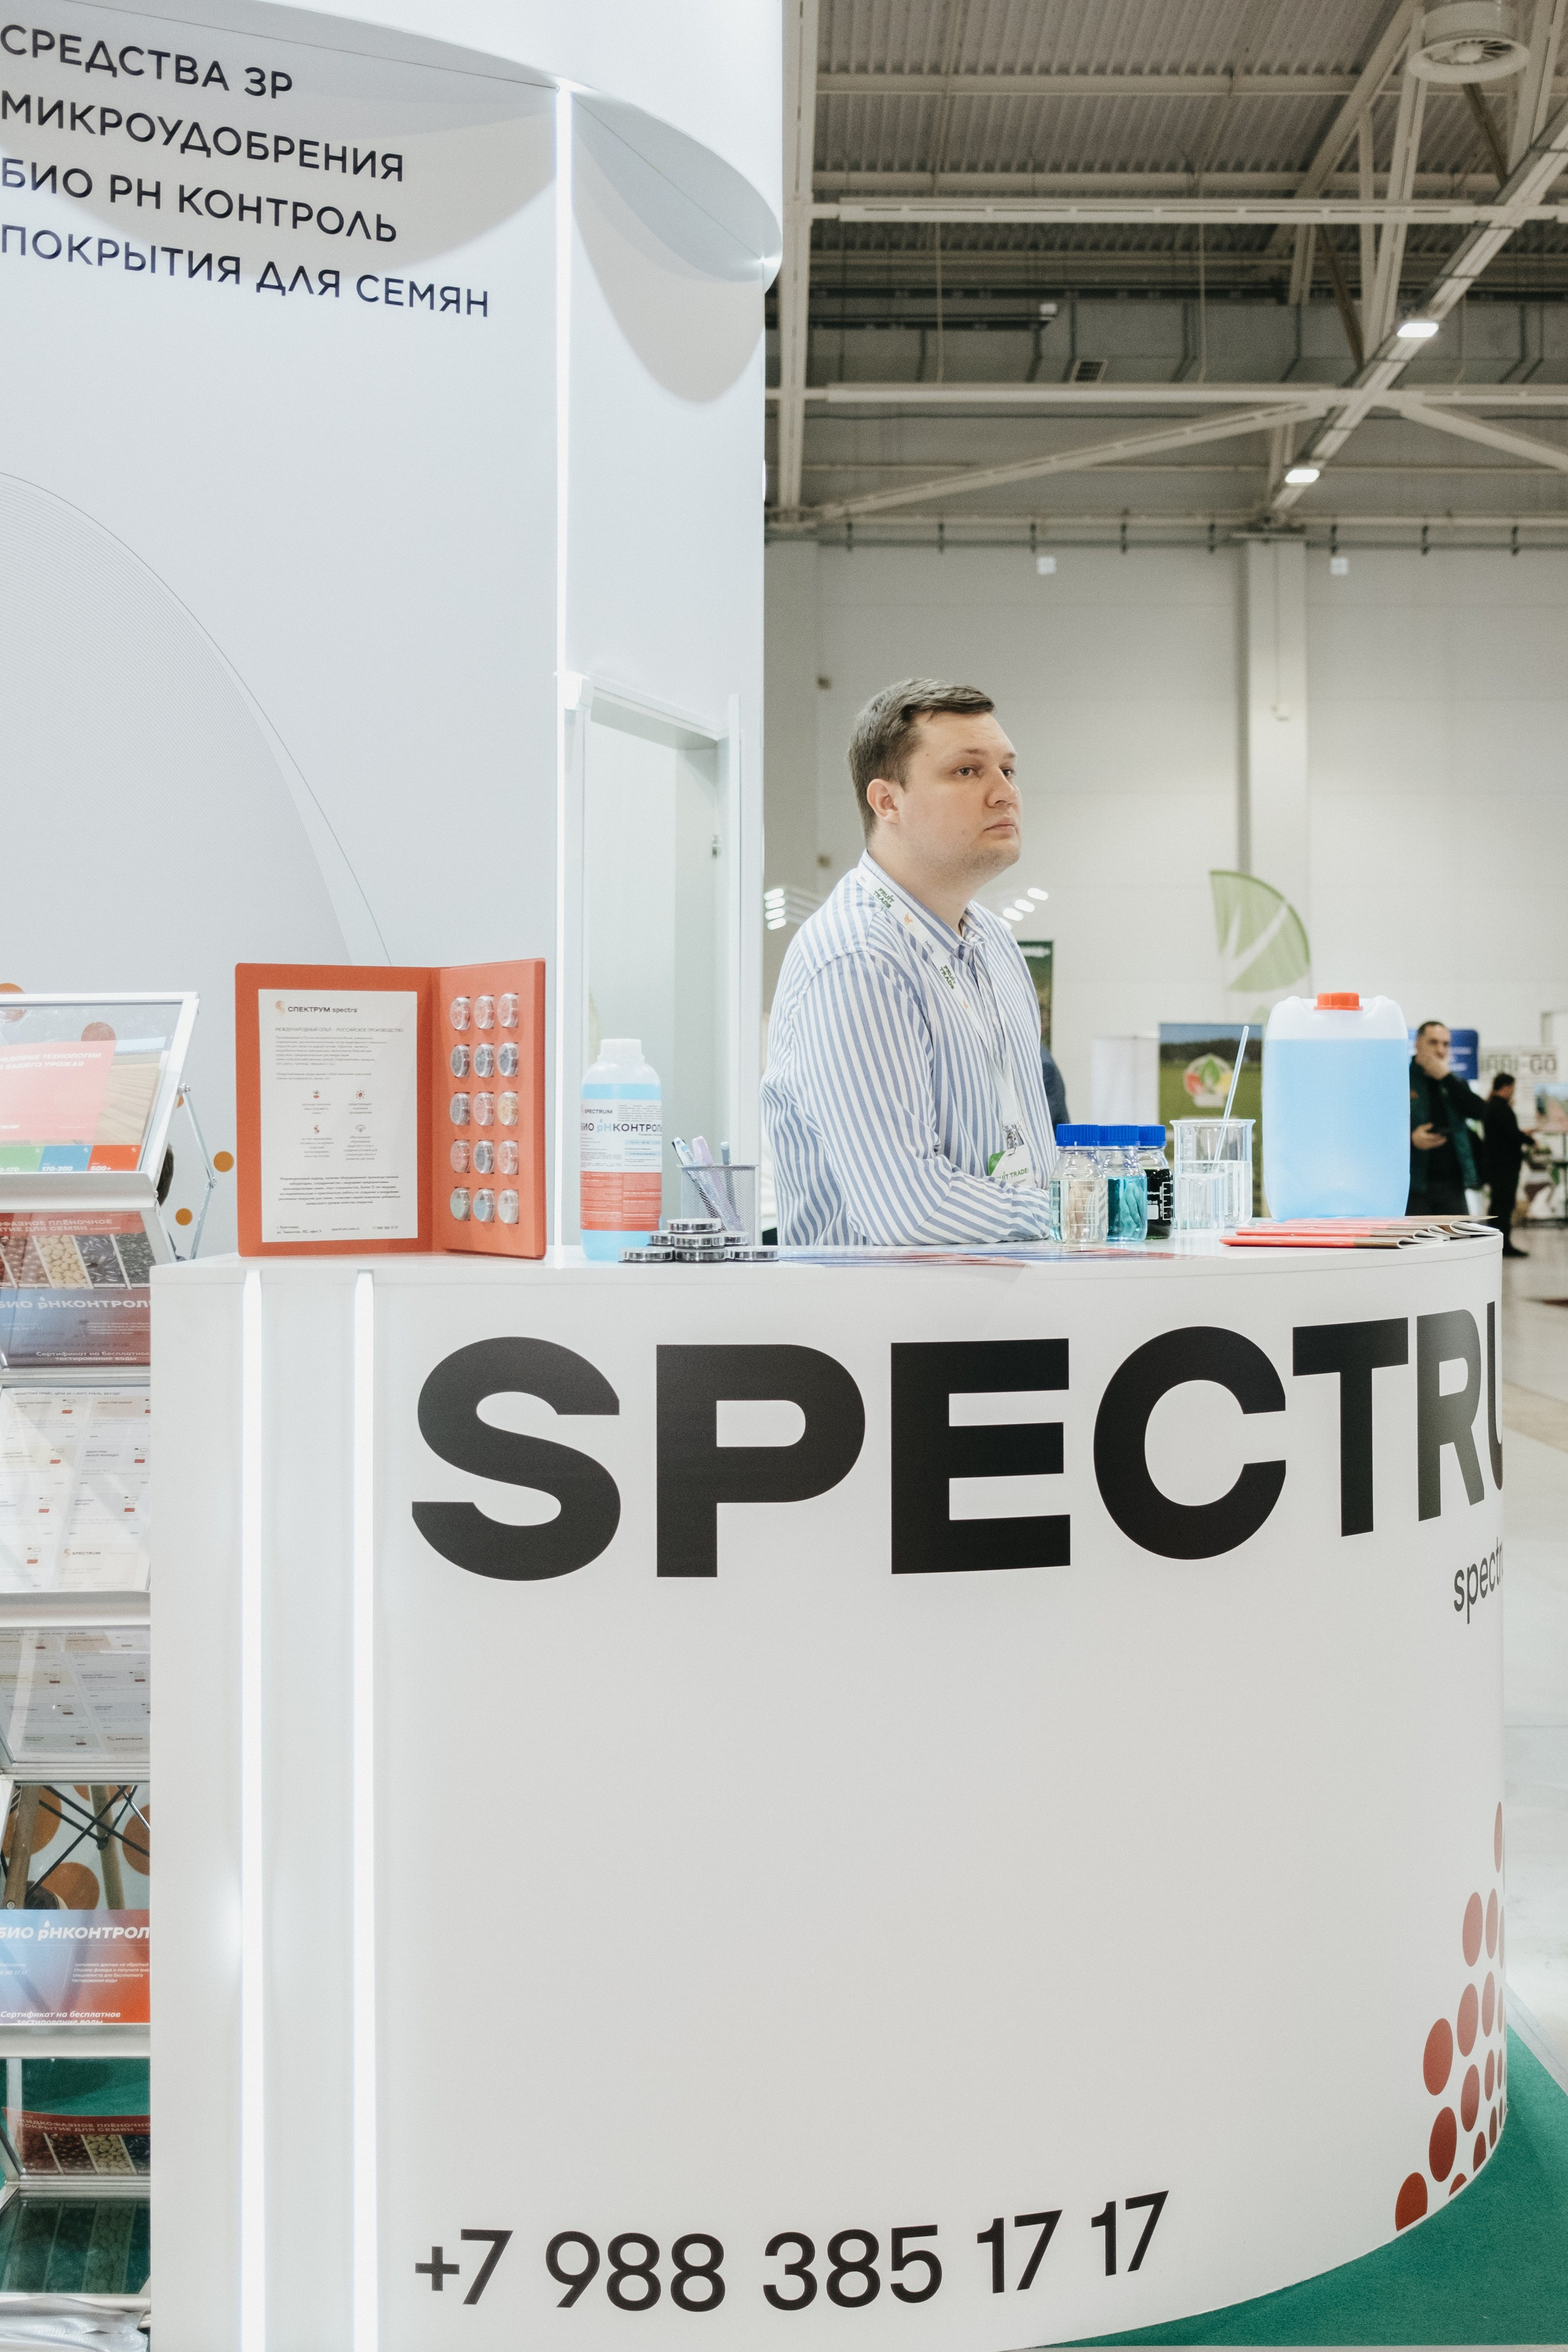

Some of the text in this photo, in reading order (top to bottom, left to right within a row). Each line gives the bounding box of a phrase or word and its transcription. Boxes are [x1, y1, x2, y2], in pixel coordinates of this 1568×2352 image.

[1, 24, 293, 100] СРЕДСТВА ЗР
[2, 90, 404, 183] МИКРОУДОБРЕНИЯ
[2, 157, 93, 199] БИО
[179, 184, 397, 243] КОНТРОЛЬ
[1, 224, 489, 318] ПОКРЫТИЯ ДЛЯ СЕМЯН
[412, 1301, 1502, 1582] SPECTRU
[1, 2011, 55, 2019] Сертификат
[18, 2118, 94, 2128] ЖИДКОФАЗНОЕ
[19, 2123, 72, 2132] ПОКРЫТИЕ
[415, 2190, 1170, 2313] +7 988 385 17 17
